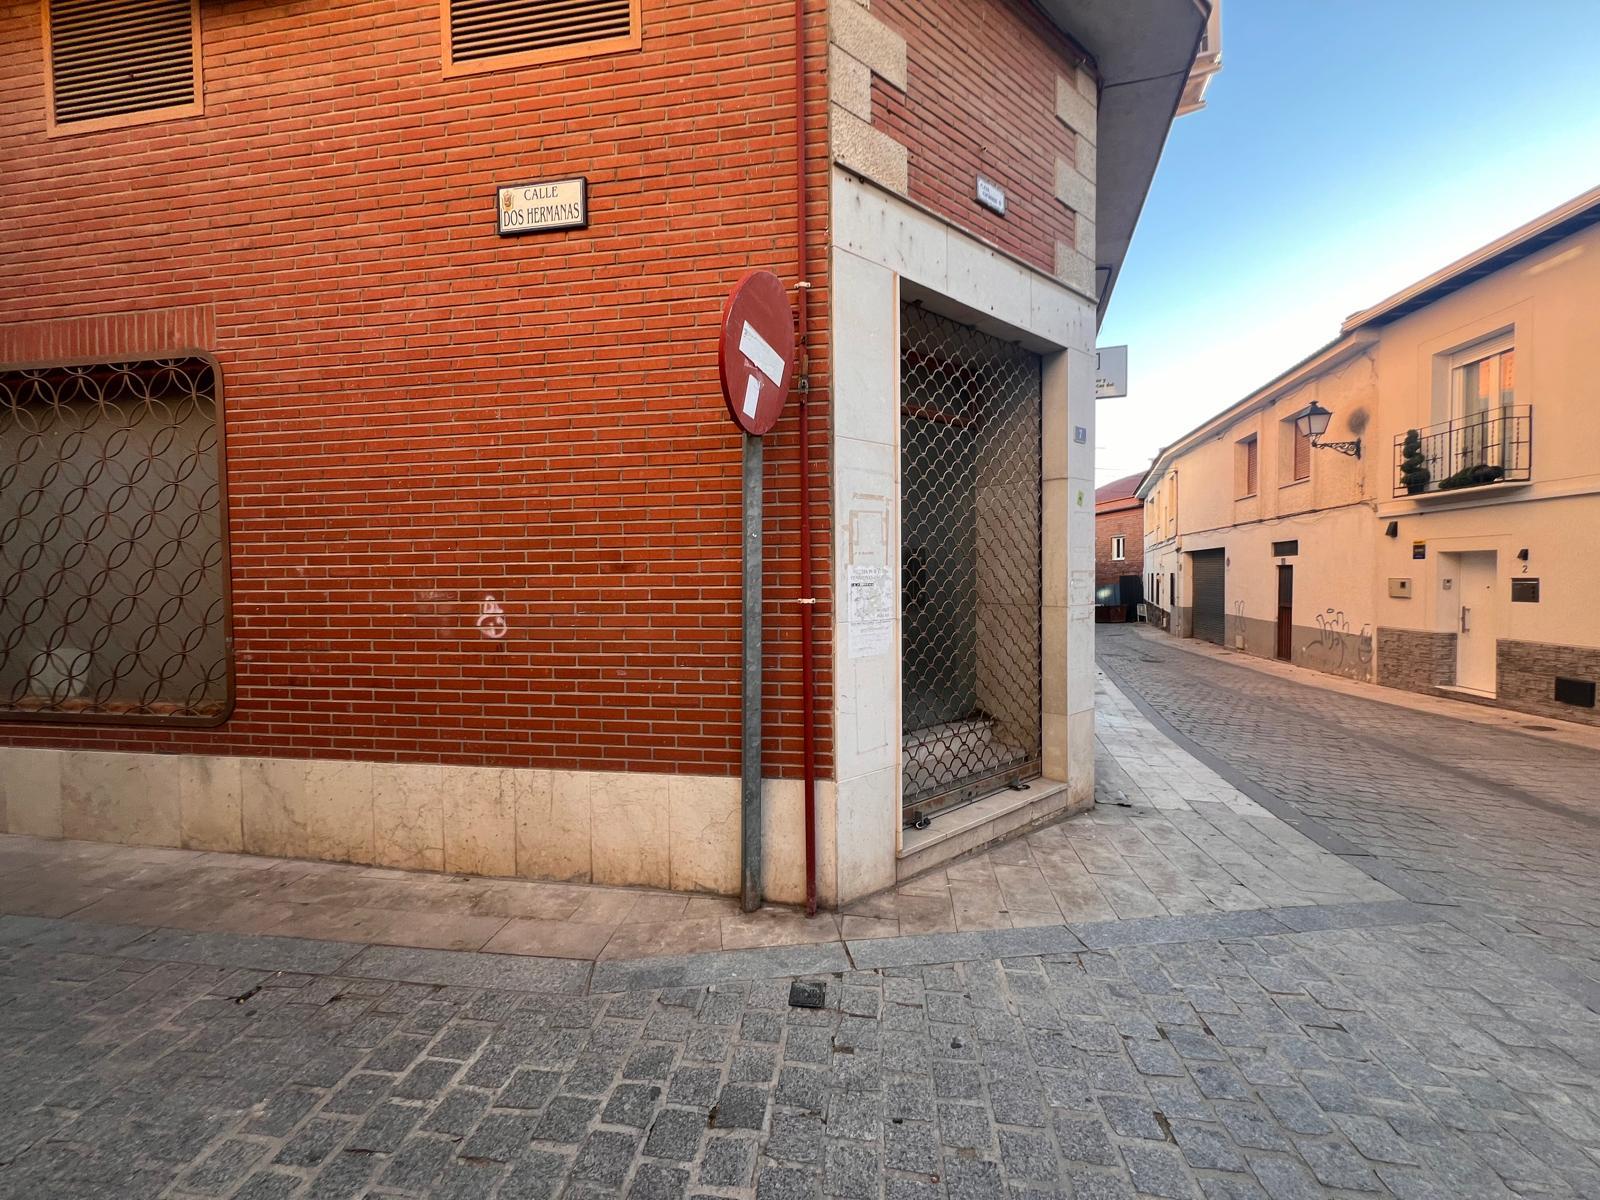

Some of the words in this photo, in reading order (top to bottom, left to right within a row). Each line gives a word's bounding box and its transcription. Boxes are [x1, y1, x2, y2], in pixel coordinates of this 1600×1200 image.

[523, 186, 559, 200] CALLE
[503, 209, 524, 227] DOS
[527, 202, 580, 224] HERMANAS
[1522, 565, 1528, 573] 2
